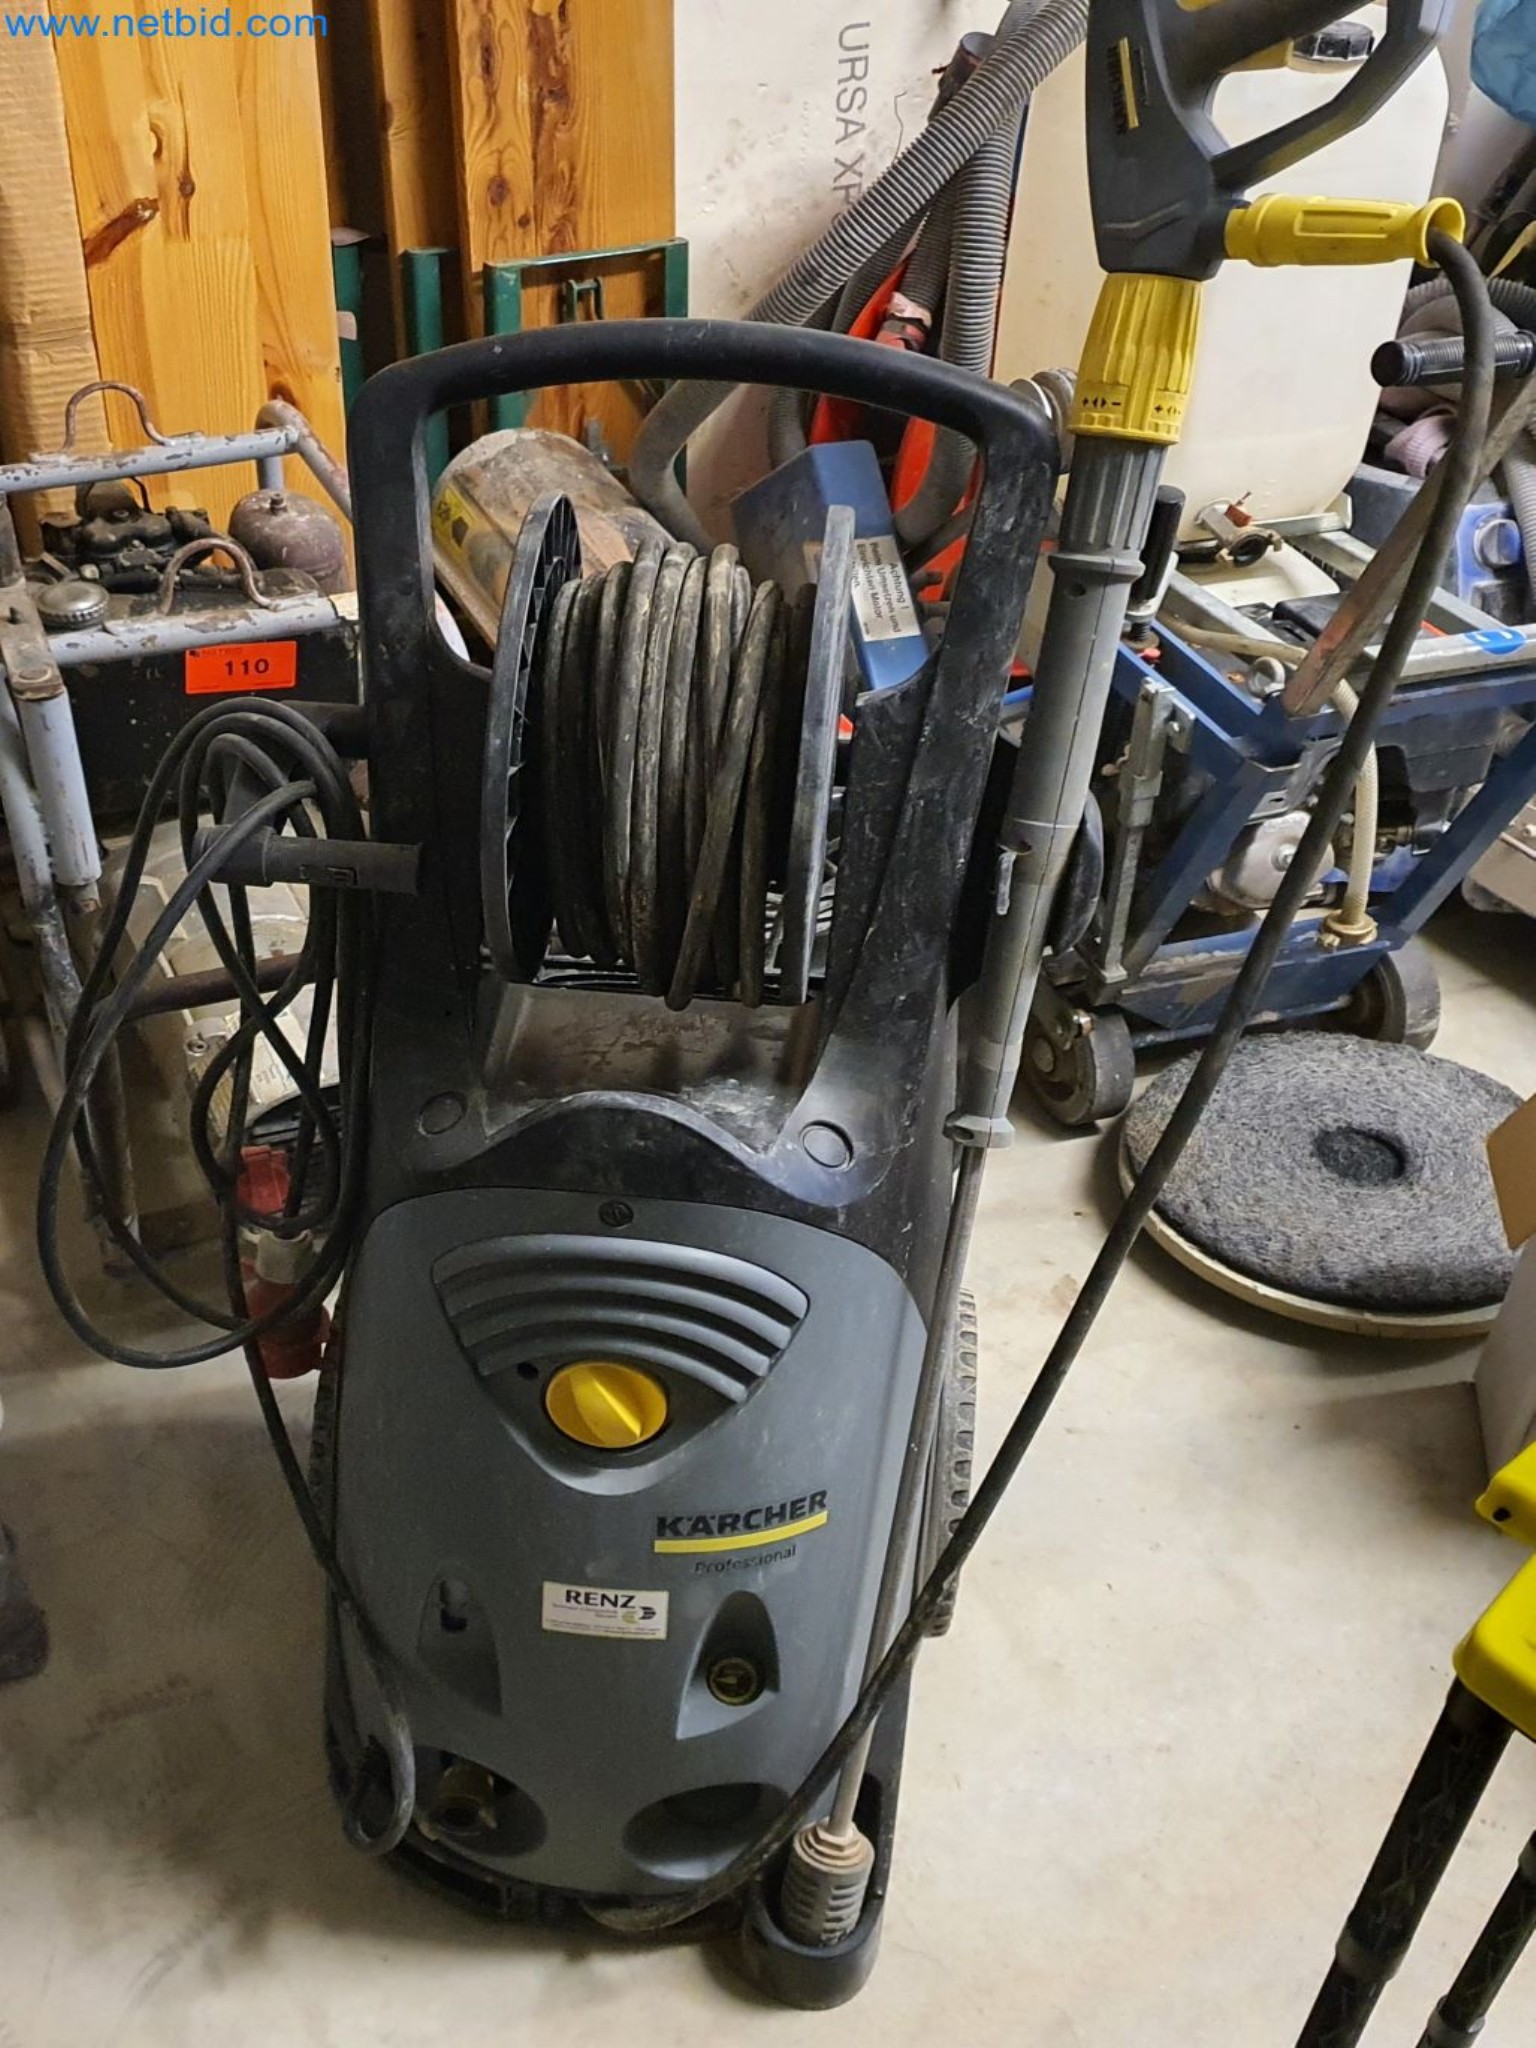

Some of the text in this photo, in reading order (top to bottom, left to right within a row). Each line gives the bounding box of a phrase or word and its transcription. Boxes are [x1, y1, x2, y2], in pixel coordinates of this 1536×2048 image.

[836, 21, 871, 145] URSA
[877, 567, 895, 613] Umsetzen
[889, 615, 903, 633] und
[889, 562, 906, 604] Achtung
[870, 592, 883, 619] Motor
[225, 658, 270, 676] 110
[656, 1489, 828, 1537] KÄRCHER
[694, 1544, 797, 1574] Professional
[565, 1589, 636, 1609] RENZ
